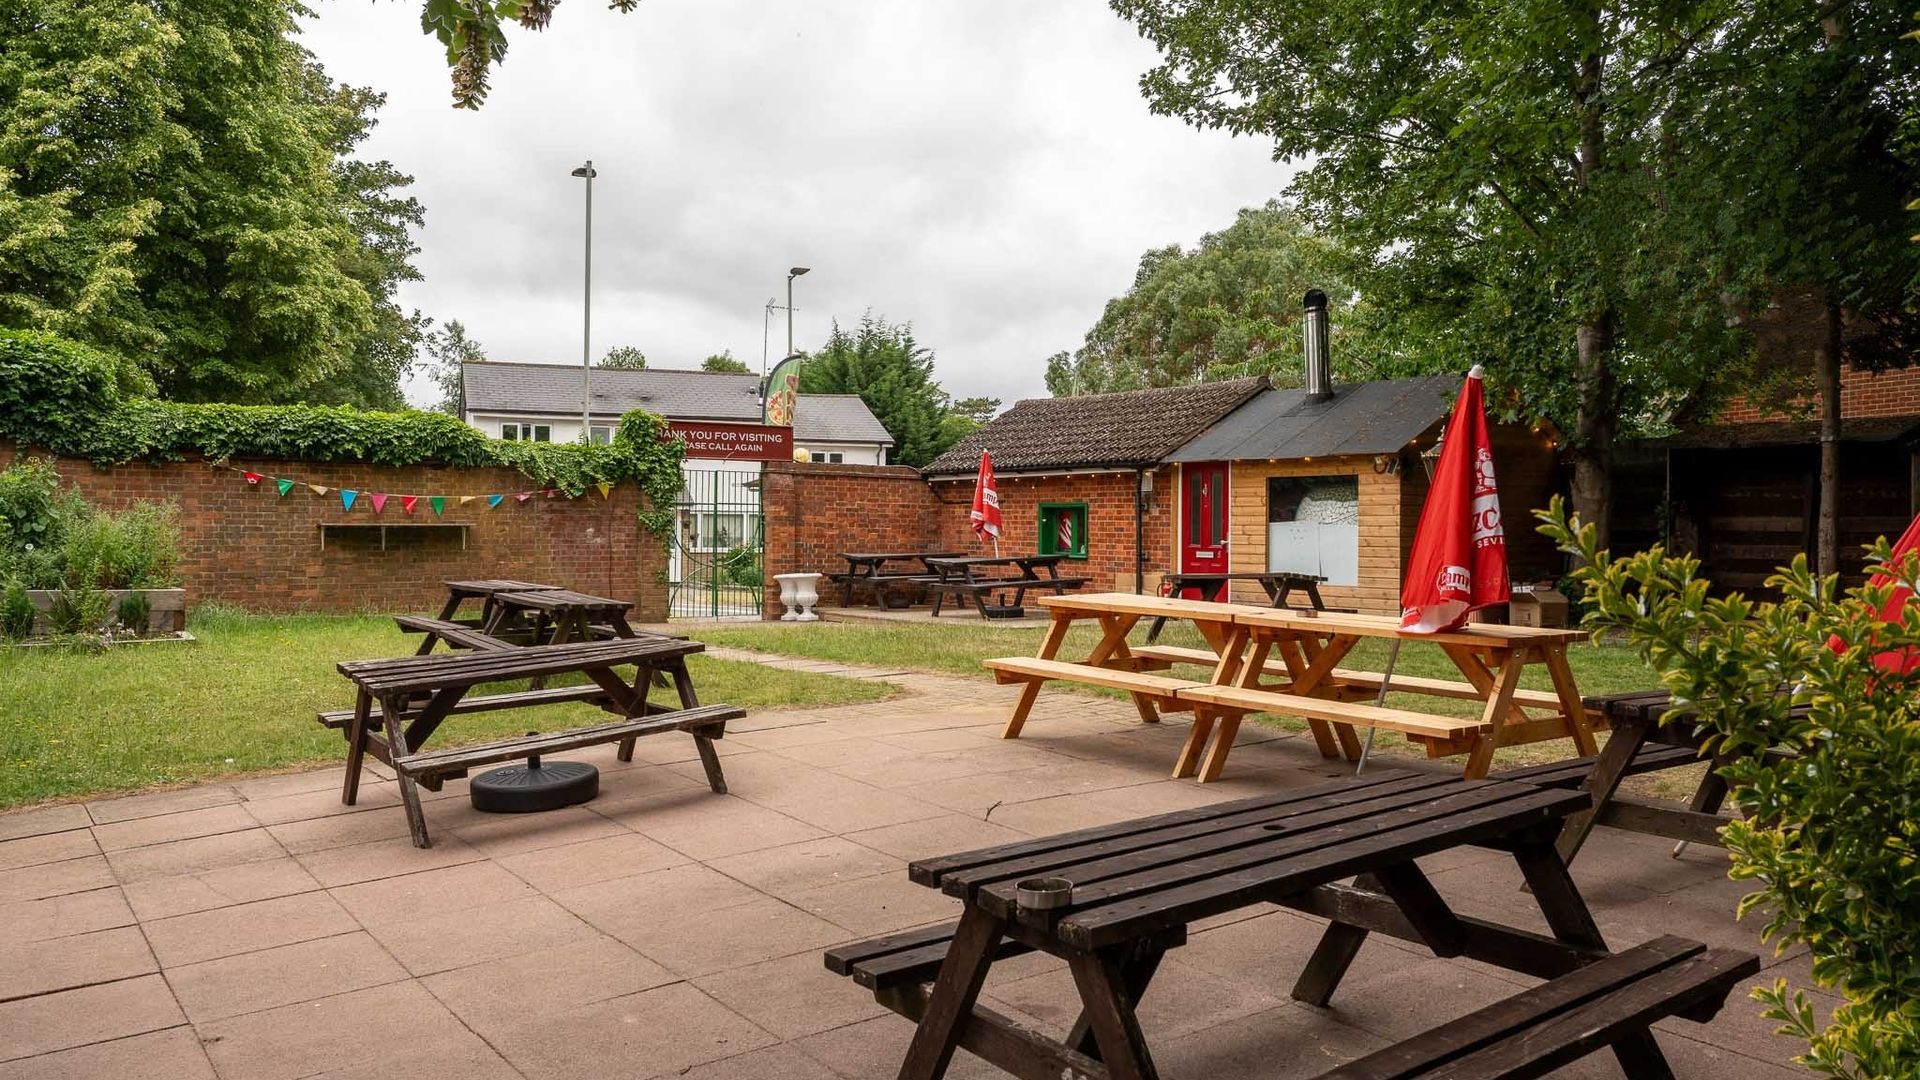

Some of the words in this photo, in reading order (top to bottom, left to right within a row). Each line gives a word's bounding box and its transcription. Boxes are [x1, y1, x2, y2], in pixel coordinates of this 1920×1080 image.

[658, 428, 687, 439] HANK
[689, 430, 712, 440] YOU
[714, 431, 736, 441] FOR
[738, 433, 783, 443] VISITING
[708, 442, 733, 451] CALL
[734, 443, 763, 452] AGAIN
[1477, 536, 1505, 549] SEVI
